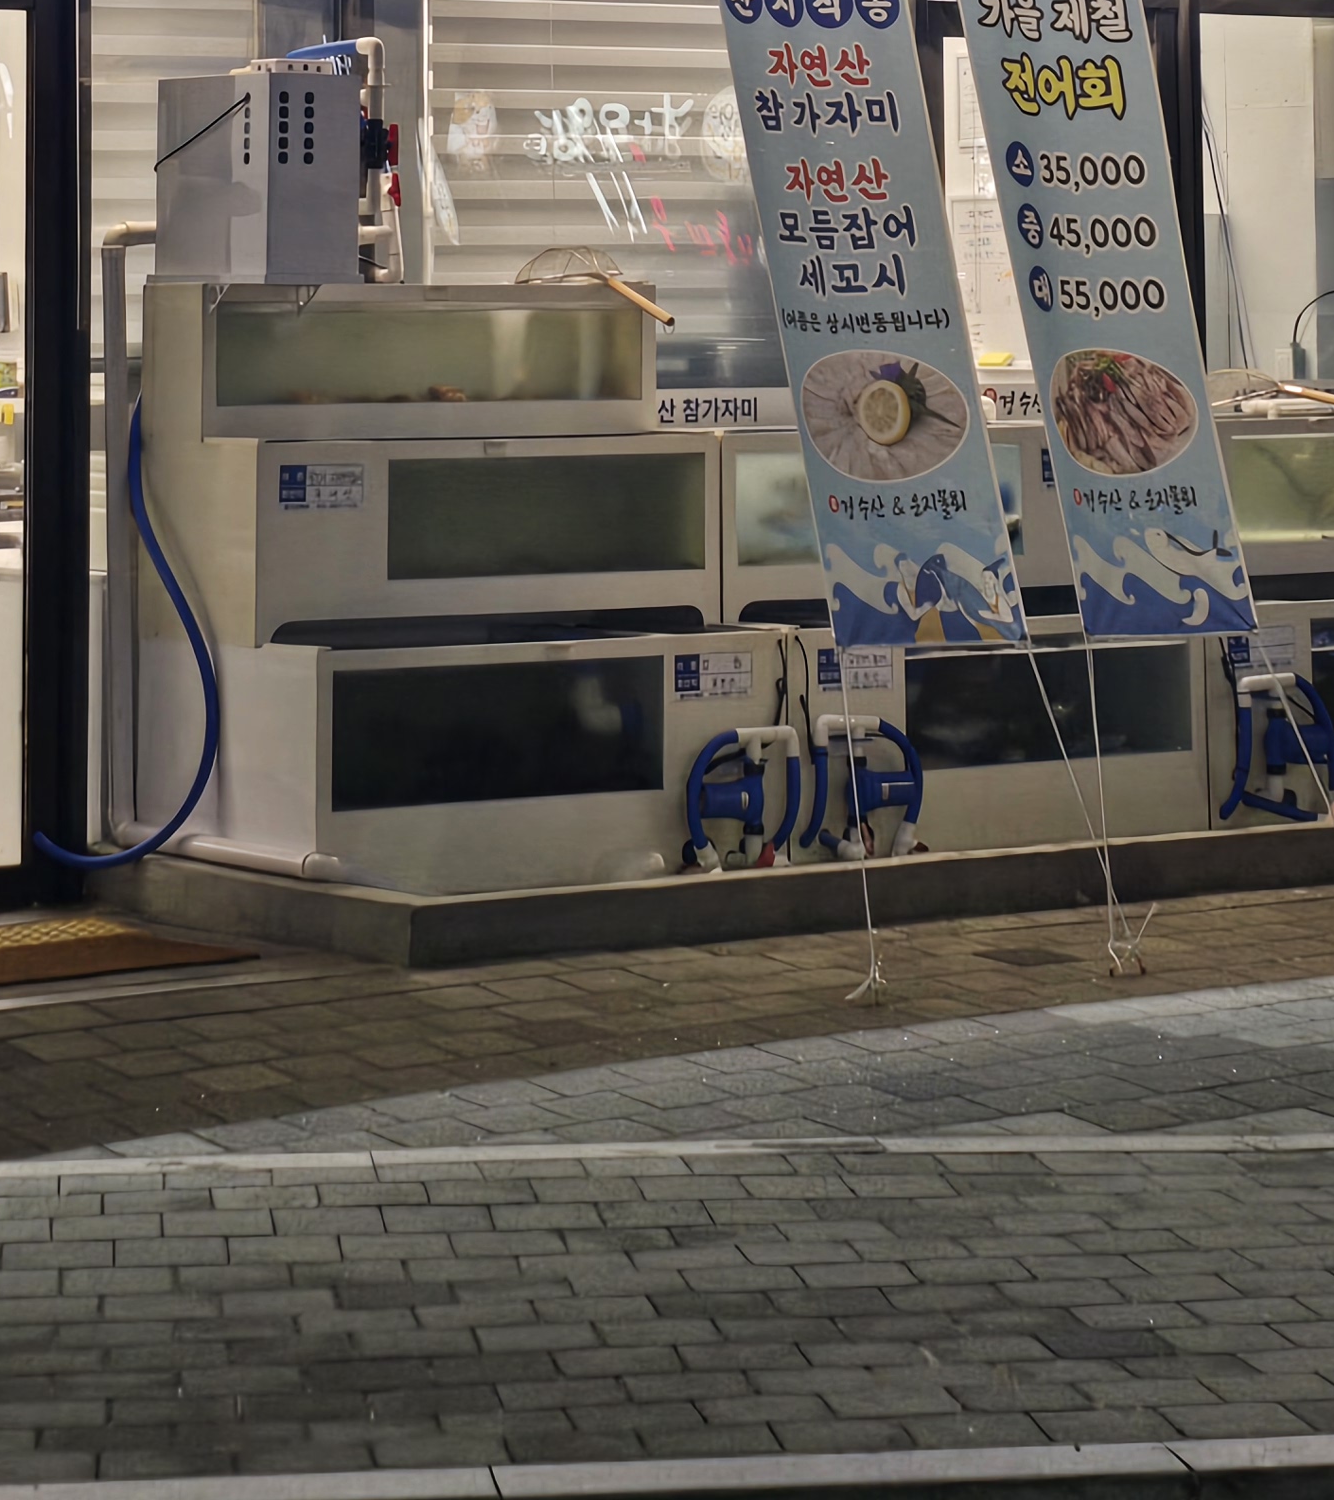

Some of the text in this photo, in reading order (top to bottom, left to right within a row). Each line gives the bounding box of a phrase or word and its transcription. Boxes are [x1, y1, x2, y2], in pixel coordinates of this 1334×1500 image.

[767, 42, 871, 88] 자연산
[1002, 52, 1127, 120] 전어회
[754, 88, 901, 134] 참가자미
[784, 156, 890, 204] 자연산
[1009, 145, 1146, 192] 소 35,000
[777, 205, 917, 251] 모듬잡어
[1020, 207, 1043, 244] 중
[1049, 216, 1157, 255] 45,000
[1058, 279, 1166, 317] 55,000
[683, 396, 758, 424] 참가자미
[893, 496, 905, 515] &
[1129, 490, 1141, 509] &
